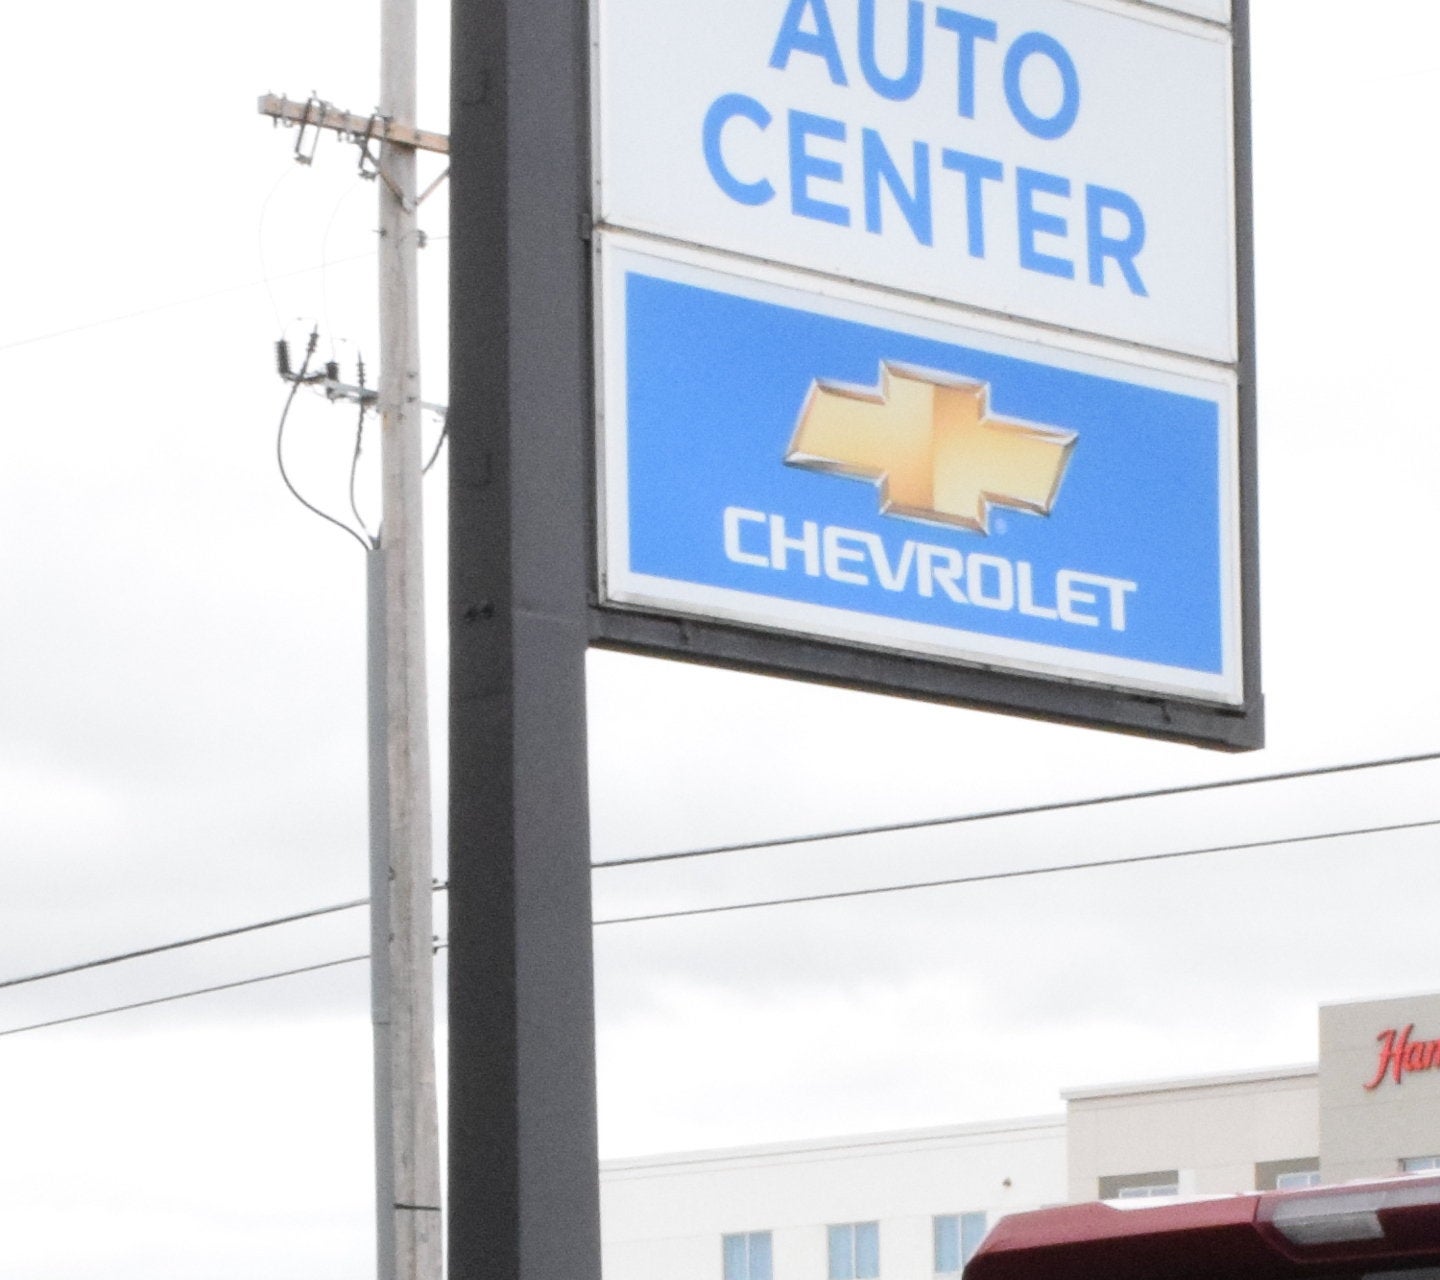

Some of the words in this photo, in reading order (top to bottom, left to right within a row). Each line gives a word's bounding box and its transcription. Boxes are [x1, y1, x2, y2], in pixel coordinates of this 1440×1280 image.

[769, 0, 1081, 141] AUTO
[702, 93, 1148, 297] CENTER
[723, 506, 1137, 632] CHEVROLET
